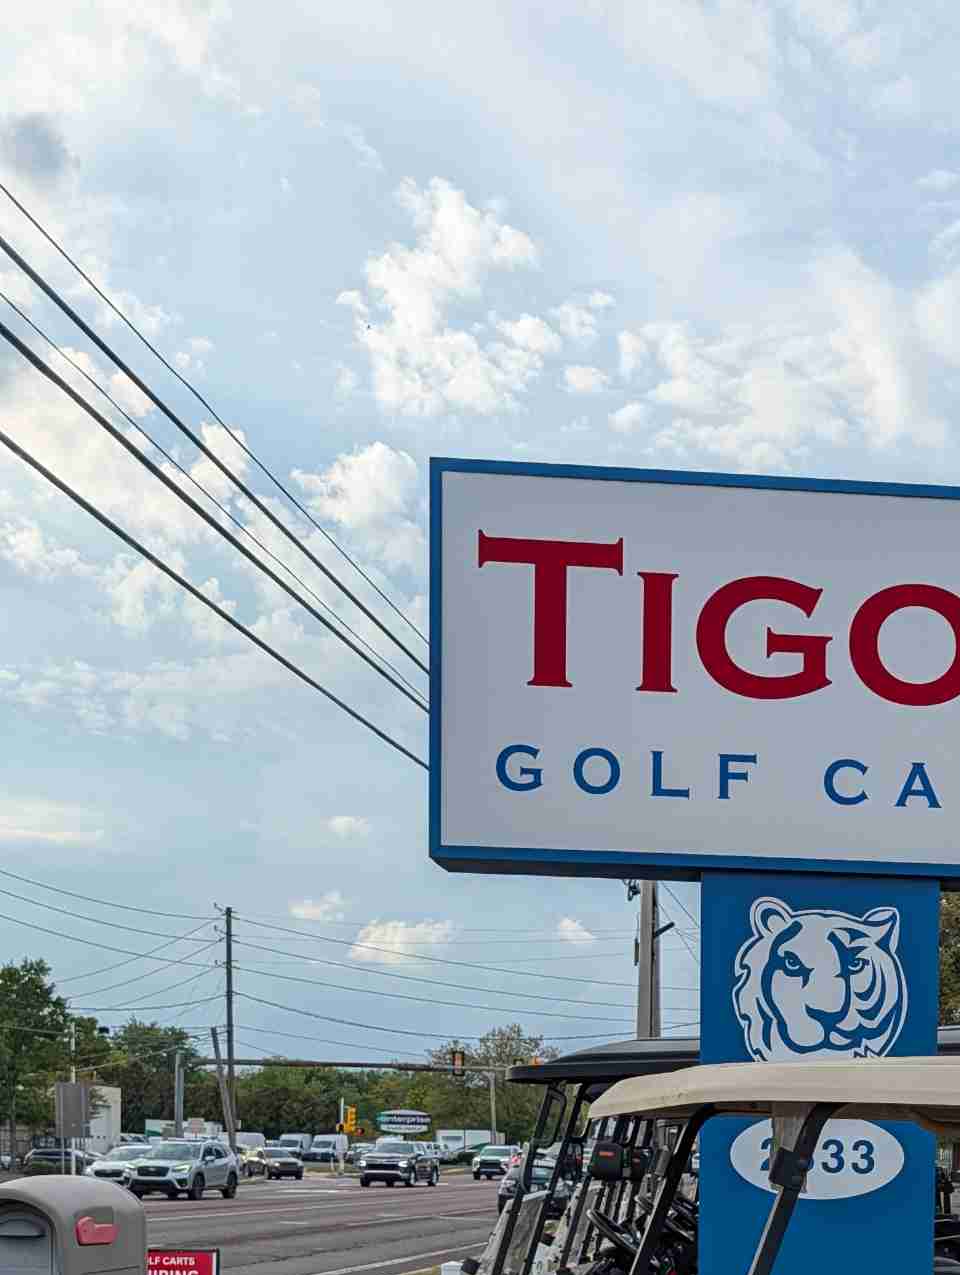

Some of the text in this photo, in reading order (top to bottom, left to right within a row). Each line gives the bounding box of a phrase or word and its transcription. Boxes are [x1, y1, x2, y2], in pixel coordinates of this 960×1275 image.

[495, 744, 758, 800] GOLF
[760, 1137, 875, 1174] 233
[147, 1256, 195, 1266] LF CARTS
